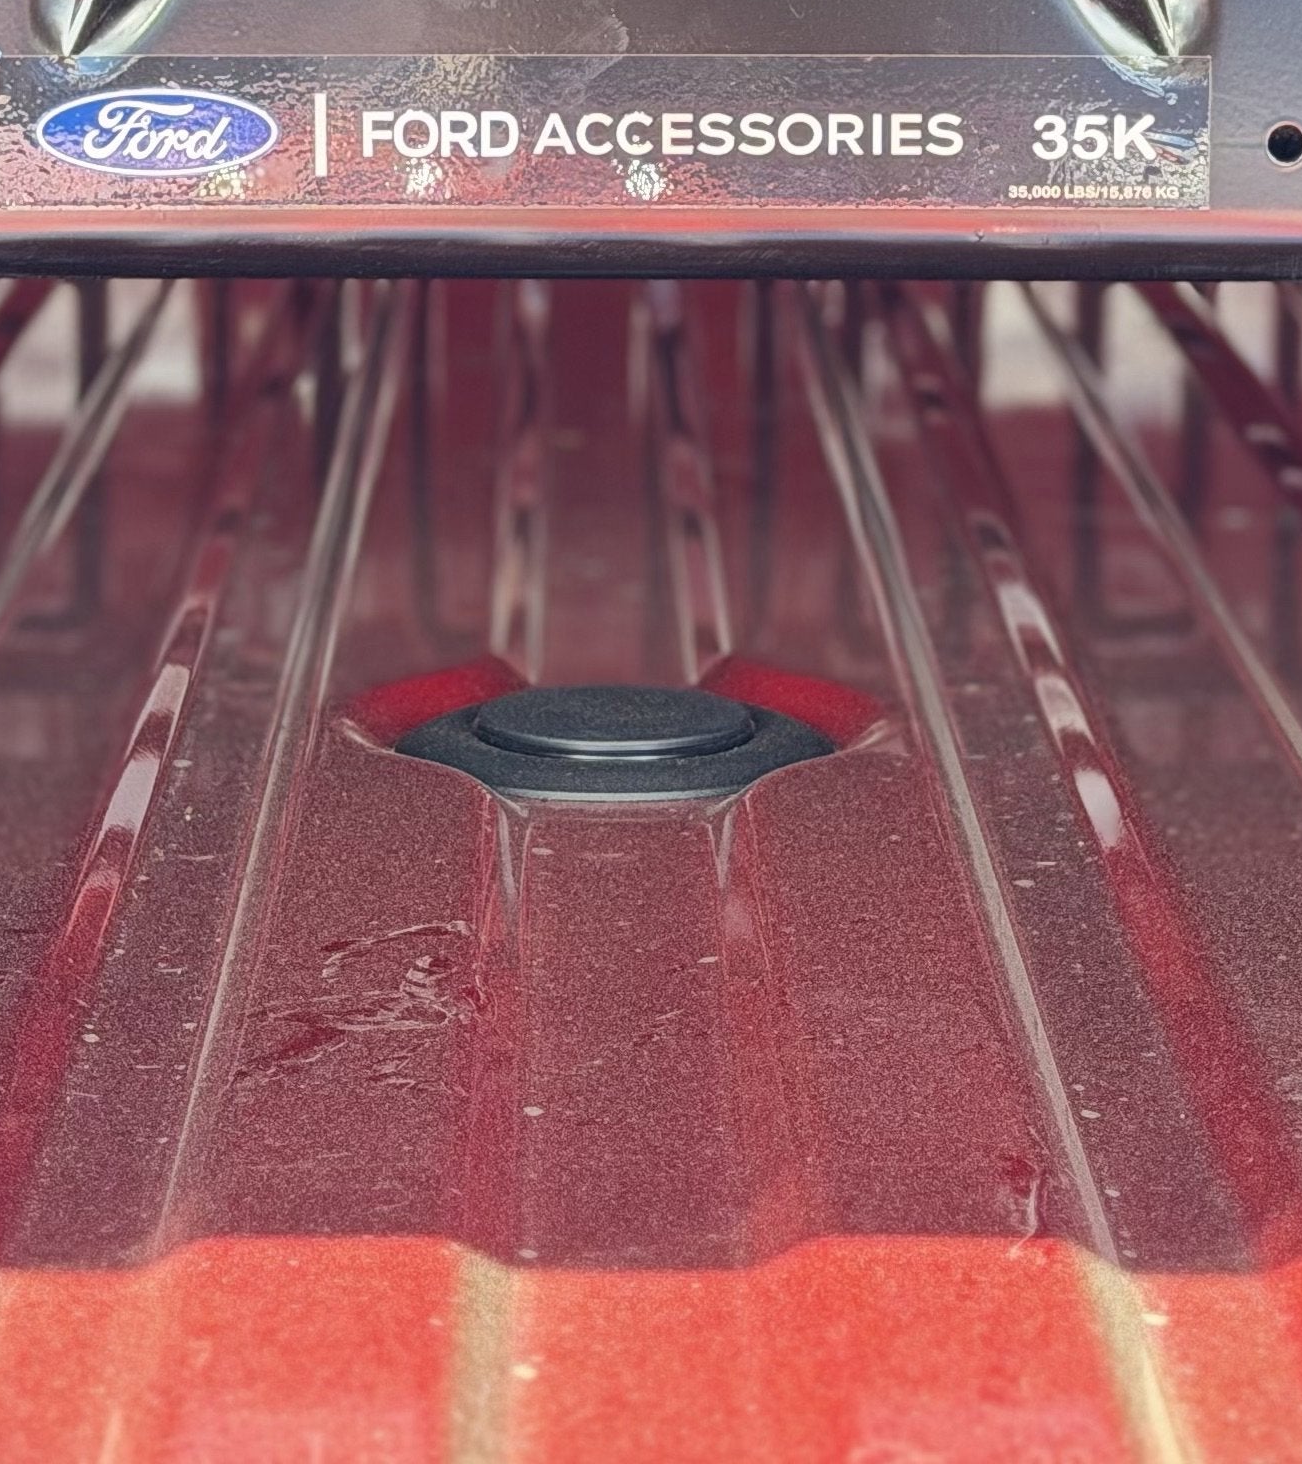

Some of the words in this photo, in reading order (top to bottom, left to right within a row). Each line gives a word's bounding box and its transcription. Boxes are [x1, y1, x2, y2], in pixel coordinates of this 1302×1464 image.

[83, 100, 230, 161] Ford
[362, 111, 520, 158] FORD
[533, 111, 964, 157] ACCESSORIES
[1032, 113, 1156, 161] 35K
[1008, 185, 1061, 200] 35,000
[1155, 186, 1179, 199] KG
